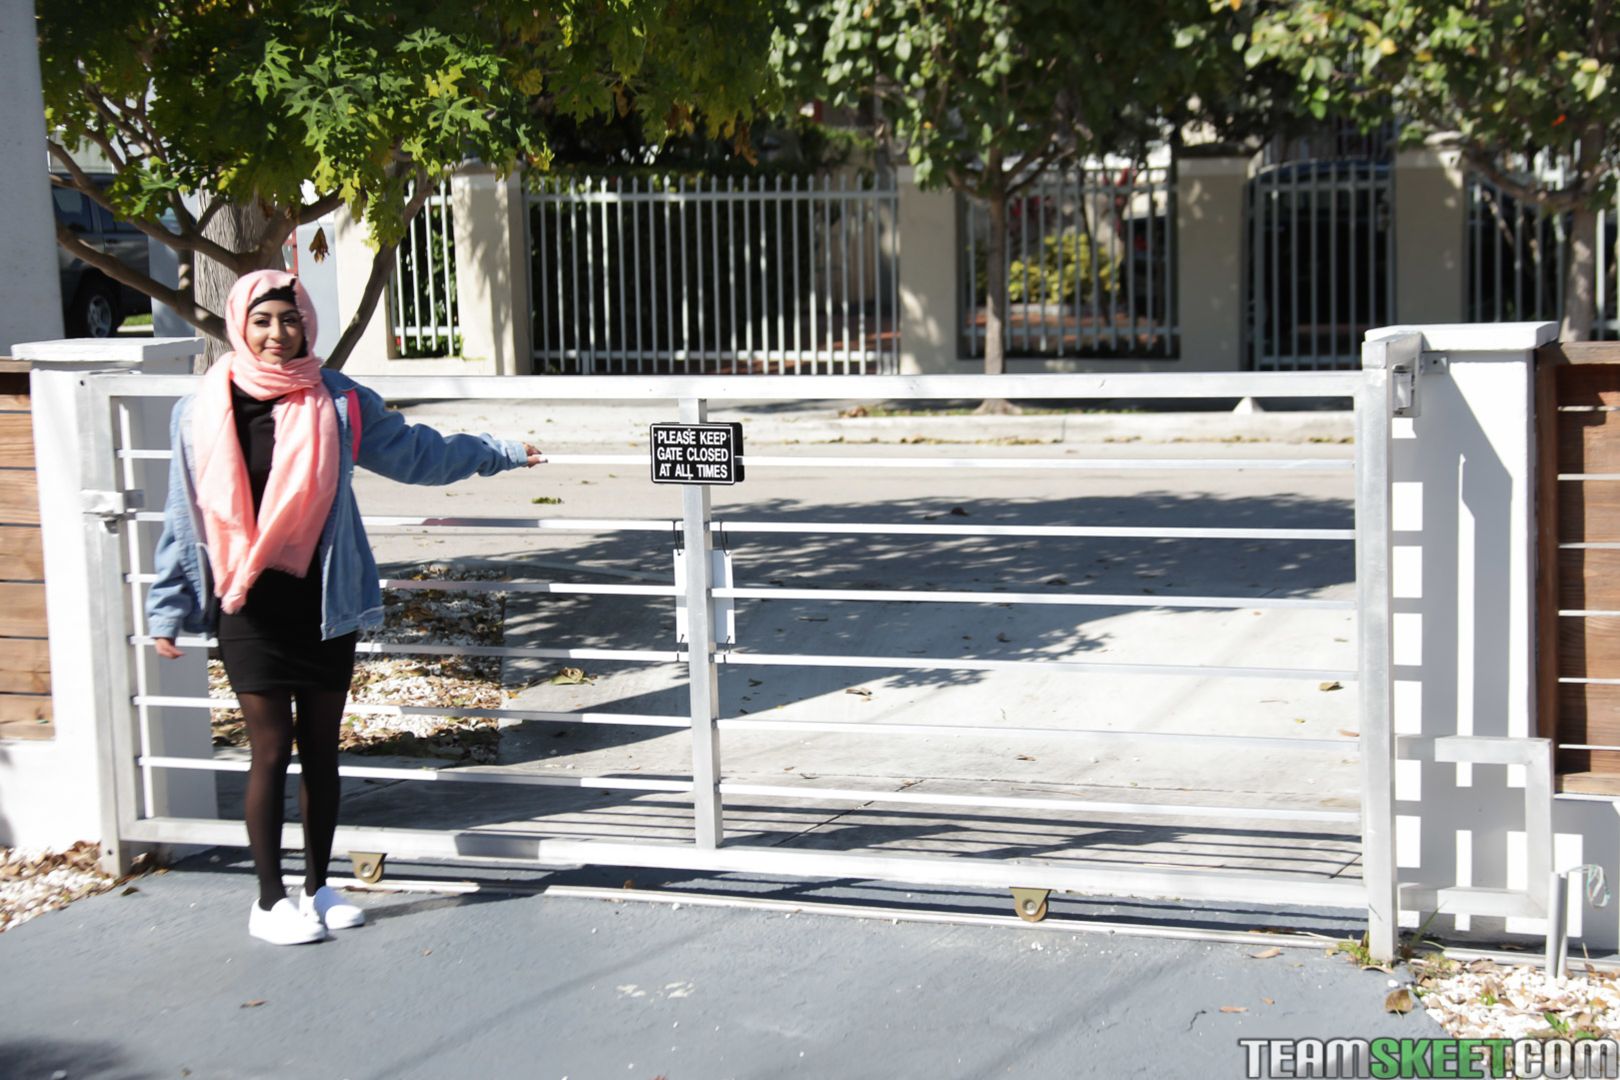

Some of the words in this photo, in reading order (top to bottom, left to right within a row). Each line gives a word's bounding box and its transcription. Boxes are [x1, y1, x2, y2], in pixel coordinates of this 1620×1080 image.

[657, 430, 697, 445] PLEASE
[700, 431, 727, 445] KEEP
[657, 446, 683, 461] GATE
[686, 447, 729, 462] CLOSED
[659, 463, 672, 477] AT
[675, 463, 694, 478] ALL
[696, 464, 728, 478] TIMES
